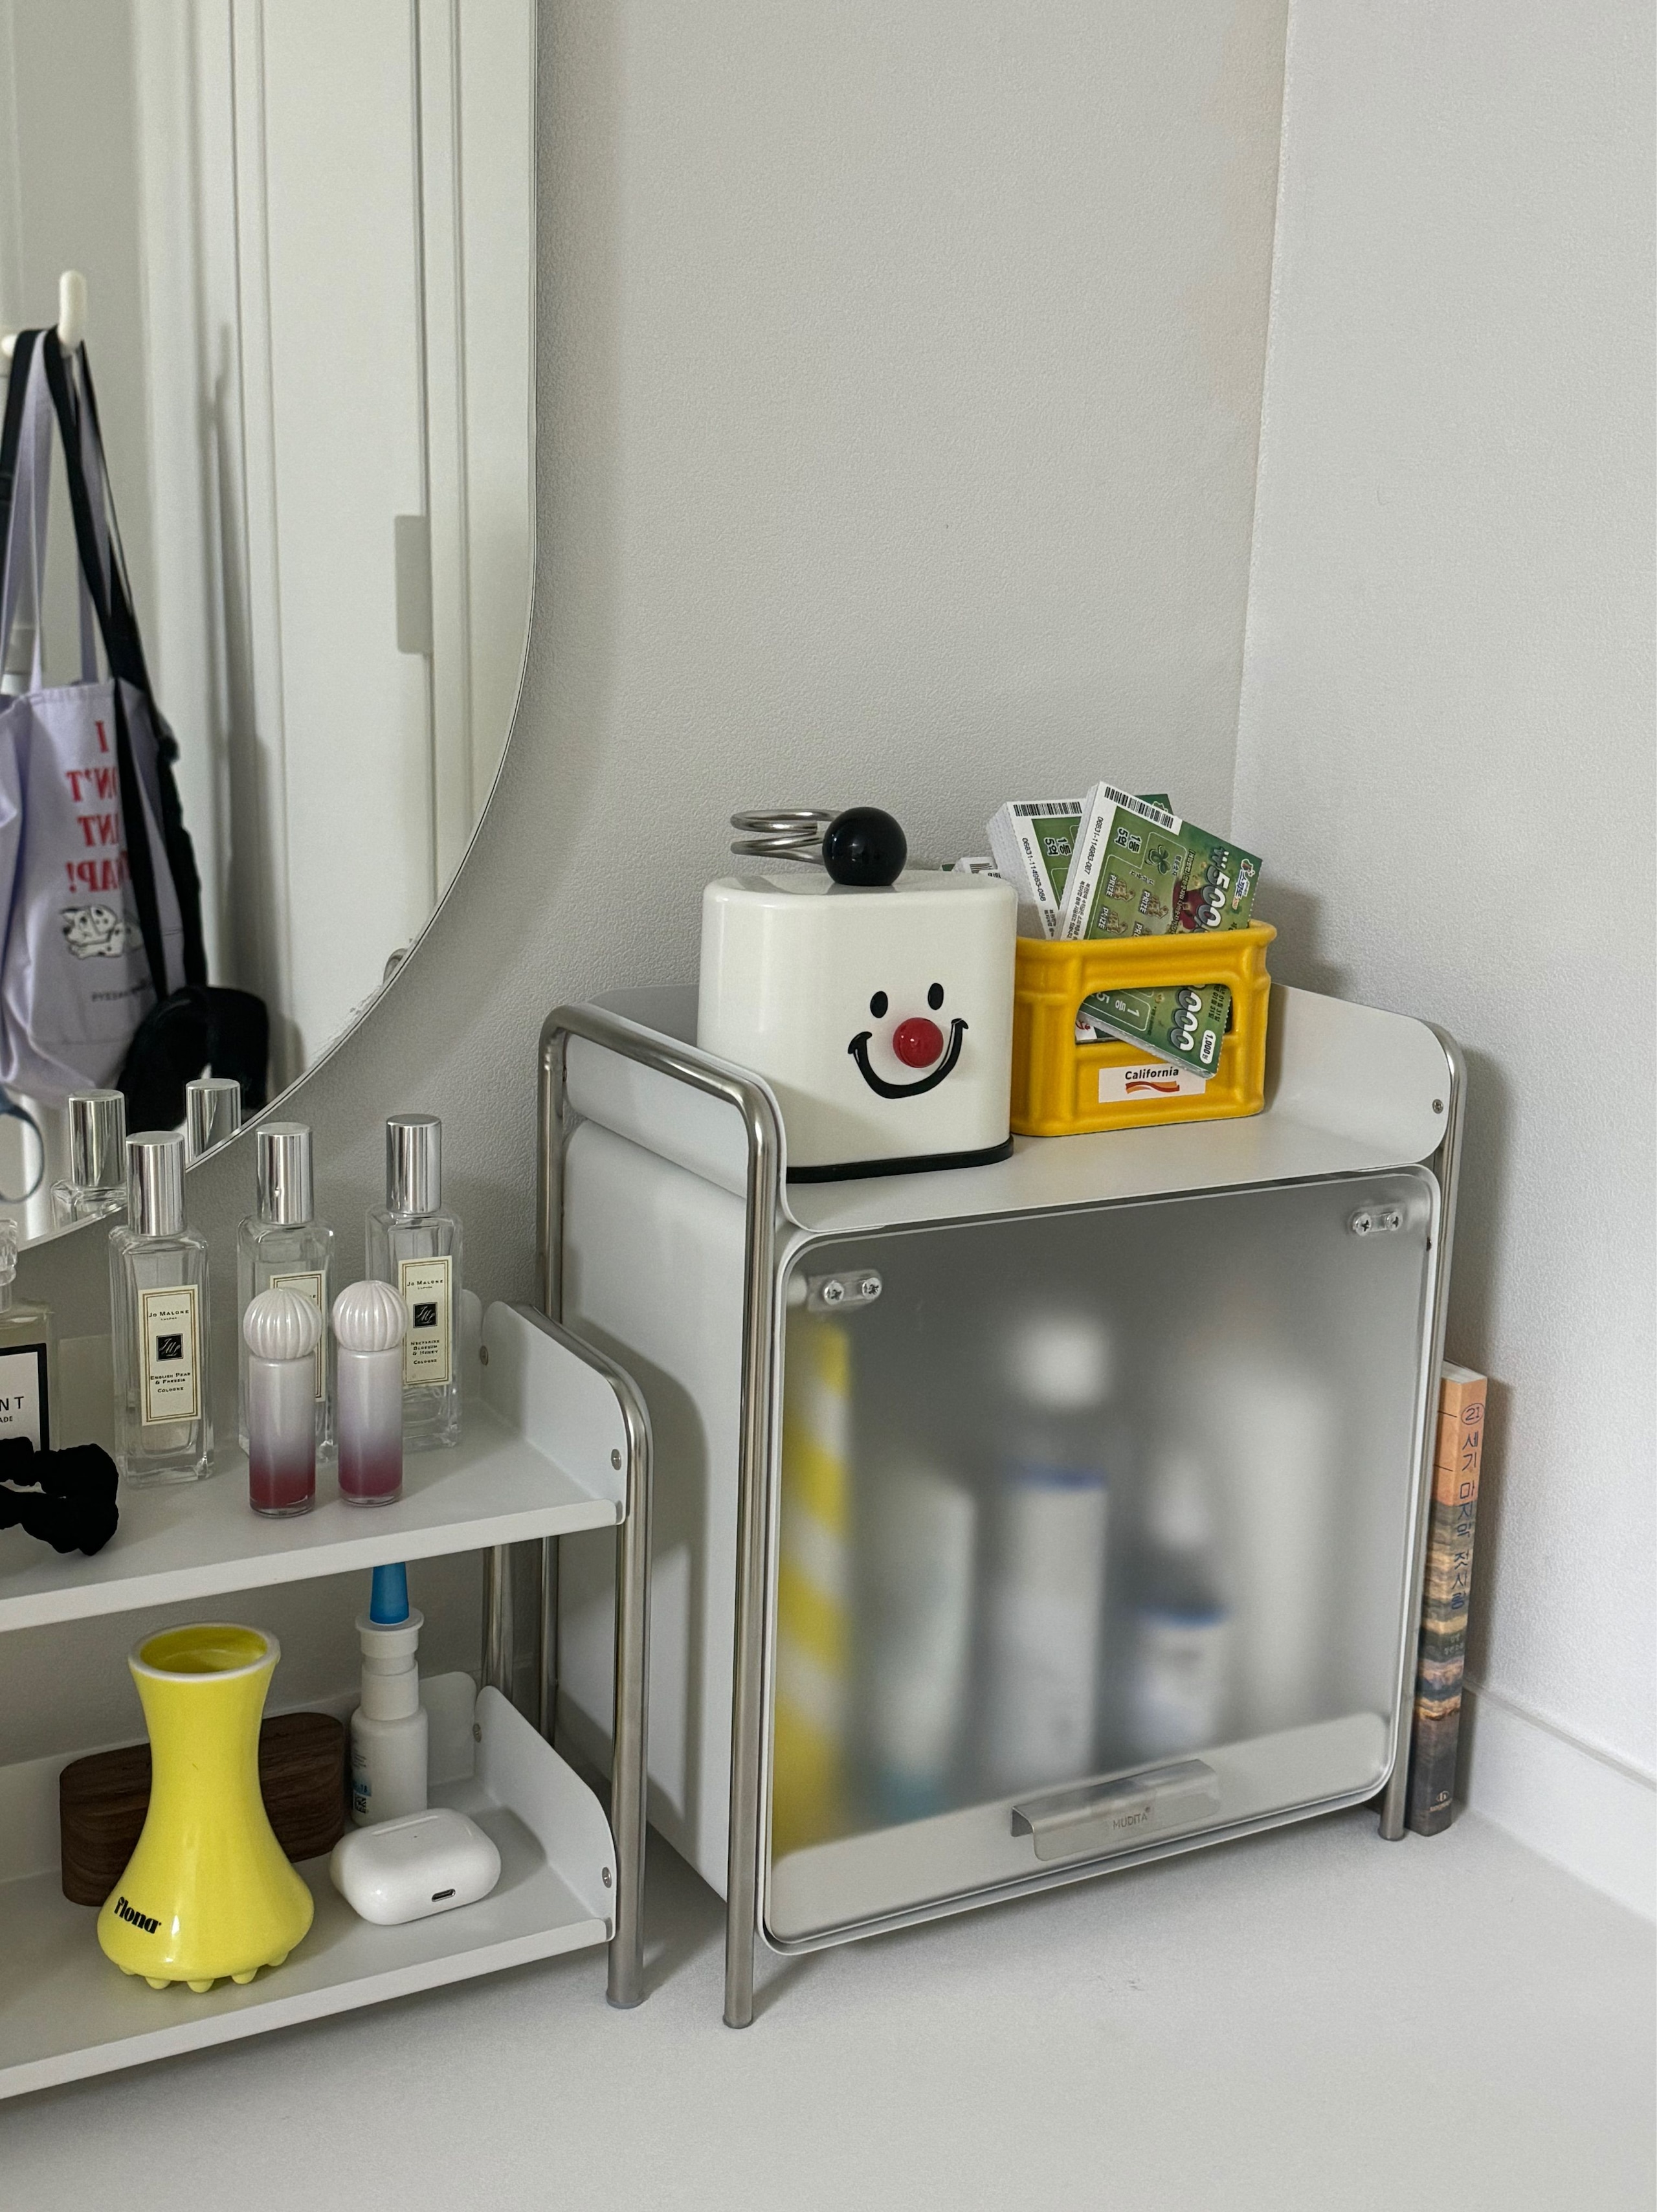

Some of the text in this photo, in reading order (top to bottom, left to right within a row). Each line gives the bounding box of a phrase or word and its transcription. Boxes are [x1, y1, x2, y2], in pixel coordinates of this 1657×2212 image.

[1045, 838, 1059, 856] 5억
[1057, 838, 1071, 855] 1등
[1115, 828, 1129, 847] 5억
[1128, 834, 1141, 853] 1등
[1106, 874, 1117, 897] PRIZE
[1140, 891, 1150, 913] PRIZE
[1125, 1067, 1179, 1080] California
[1457, 1479, 1476, 1538] 마지막
[1113, 1813, 1148, 1830] MUDITA
